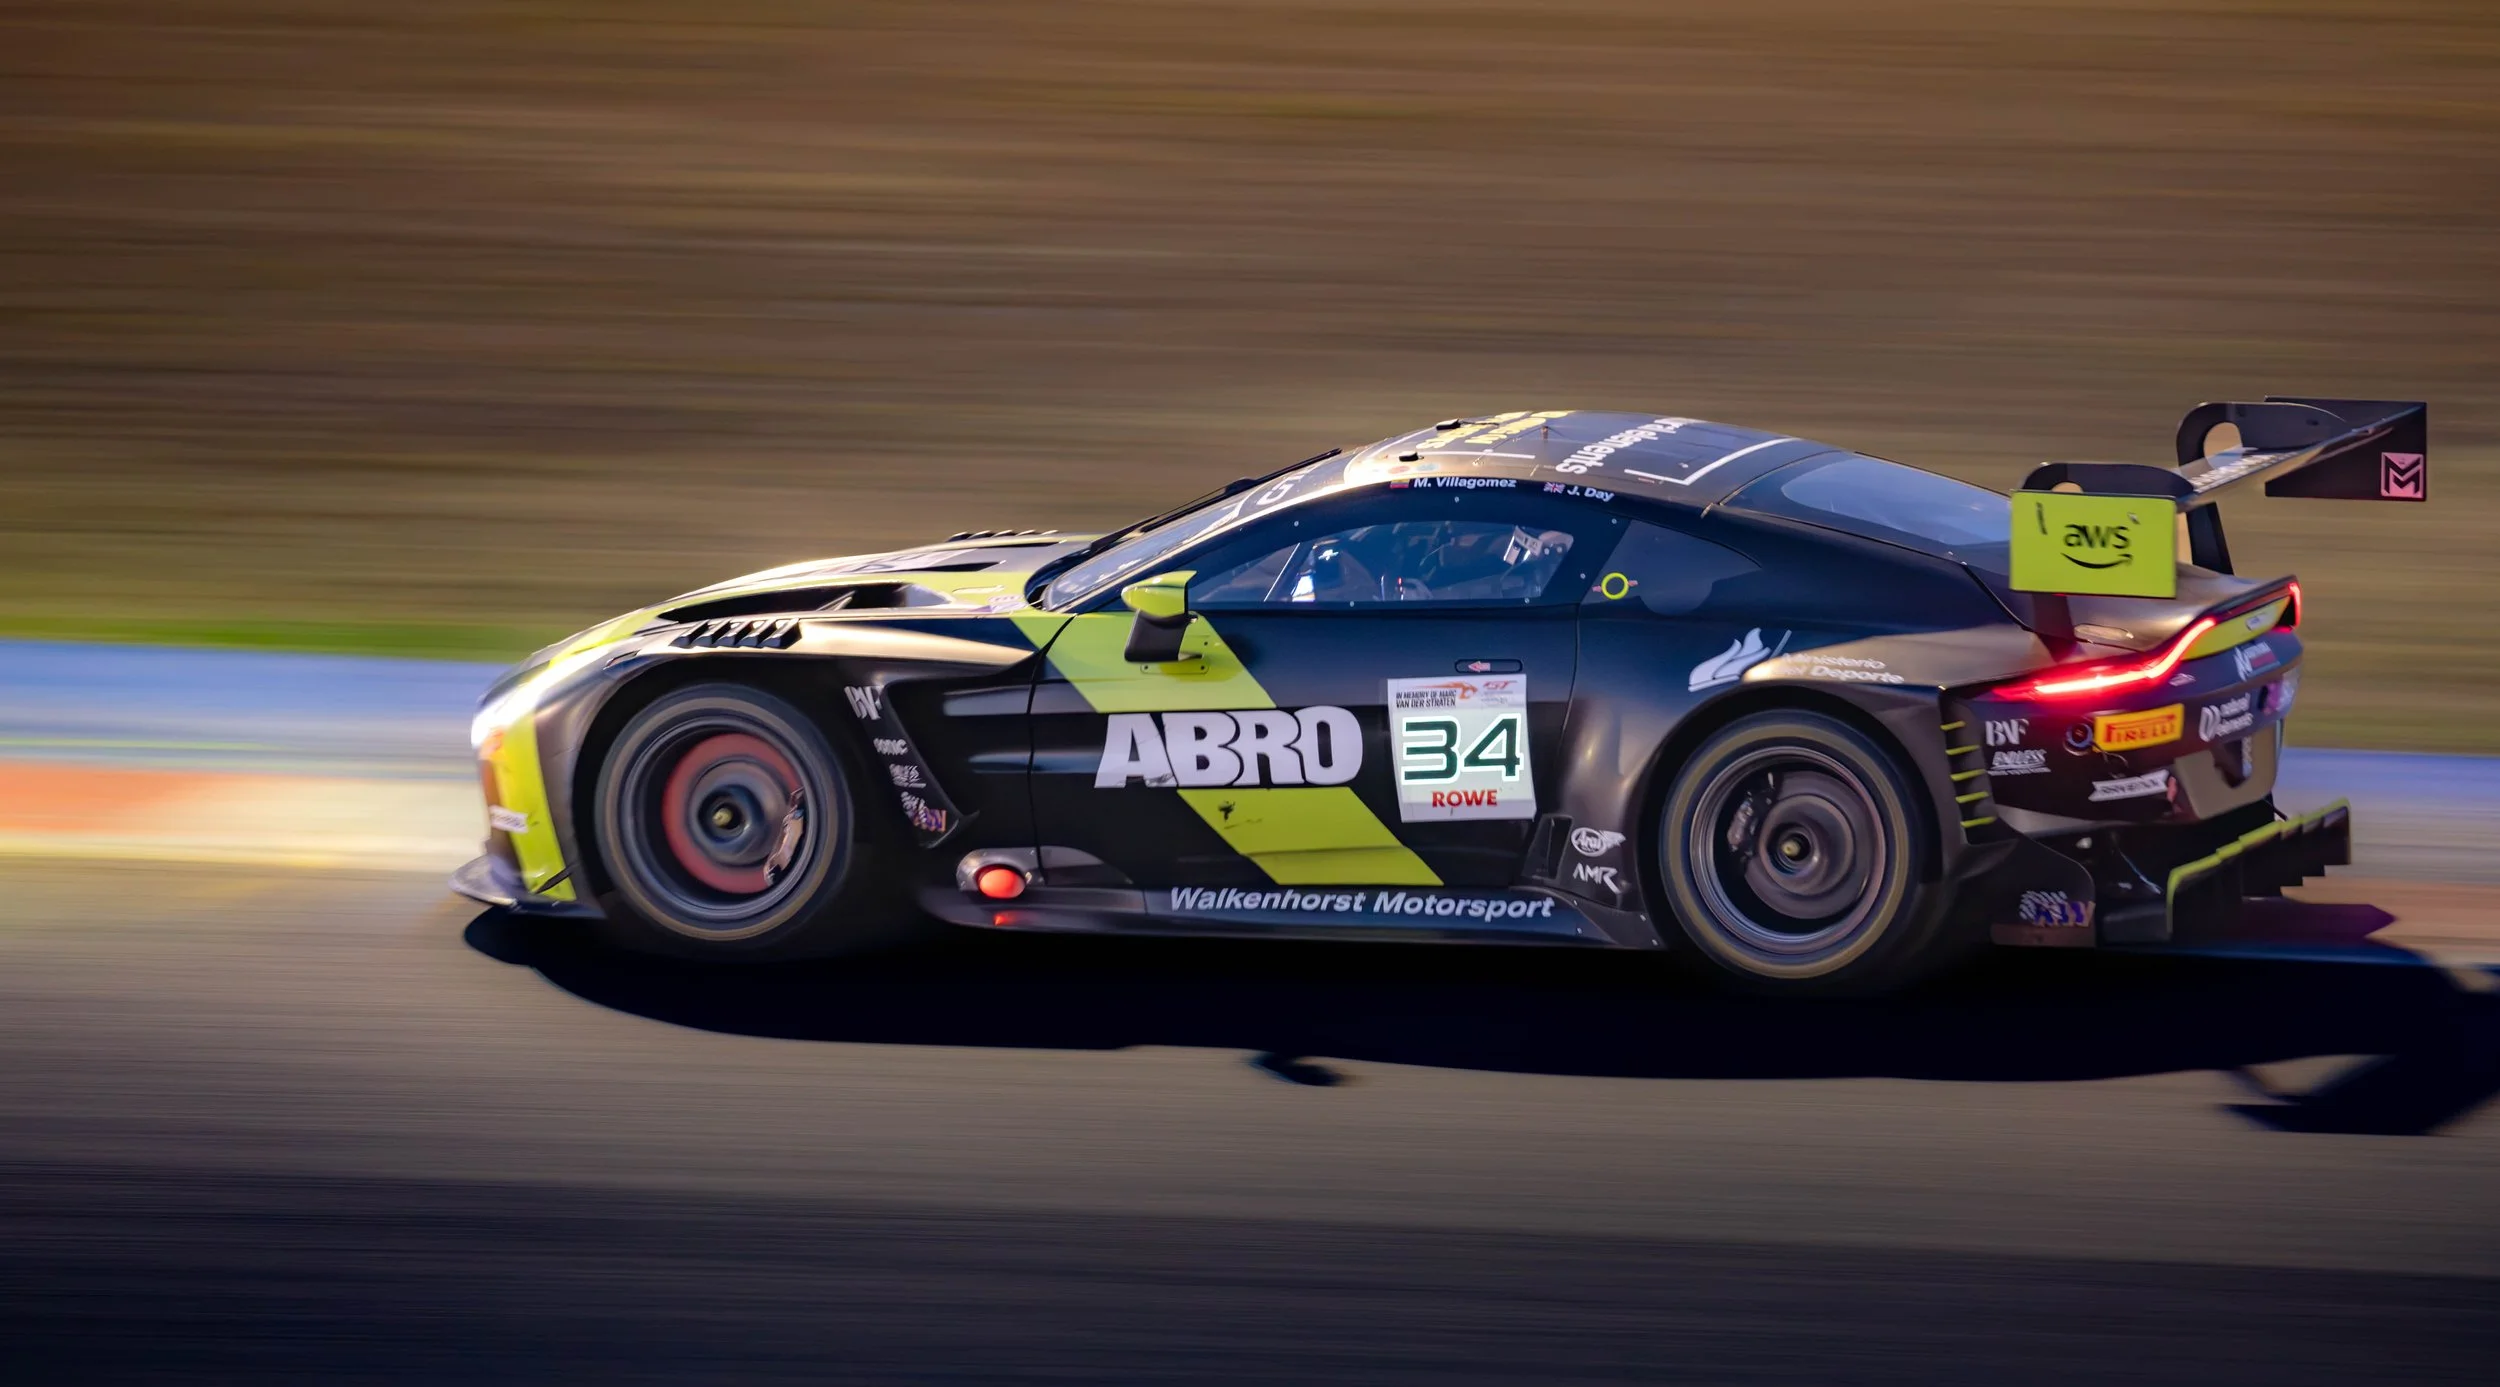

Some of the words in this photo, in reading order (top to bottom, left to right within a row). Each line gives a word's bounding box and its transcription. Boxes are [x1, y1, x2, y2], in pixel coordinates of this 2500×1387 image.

[1414, 478, 1431, 488] M.
[1437, 477, 1516, 489] Villagomez
[1567, 485, 1580, 496] J.
[1584, 487, 1615, 501] Day
[2064, 523, 2130, 549] aws
[1396, 699, 1410, 708] VAN
[1411, 699, 1425, 708] DER
[1426, 697, 1456, 708] STRATEN
[1403, 691, 1430, 699] MEMORY
[1094, 705, 1363, 788] ABRO
[1402, 714, 1523, 784] 34
[1432, 789, 1498, 808] ROWE
[1572, 862, 1621, 894] AMR
[1171, 887, 1366, 912] Walkenhorst
[1373, 891, 1555, 922] Motorsport
